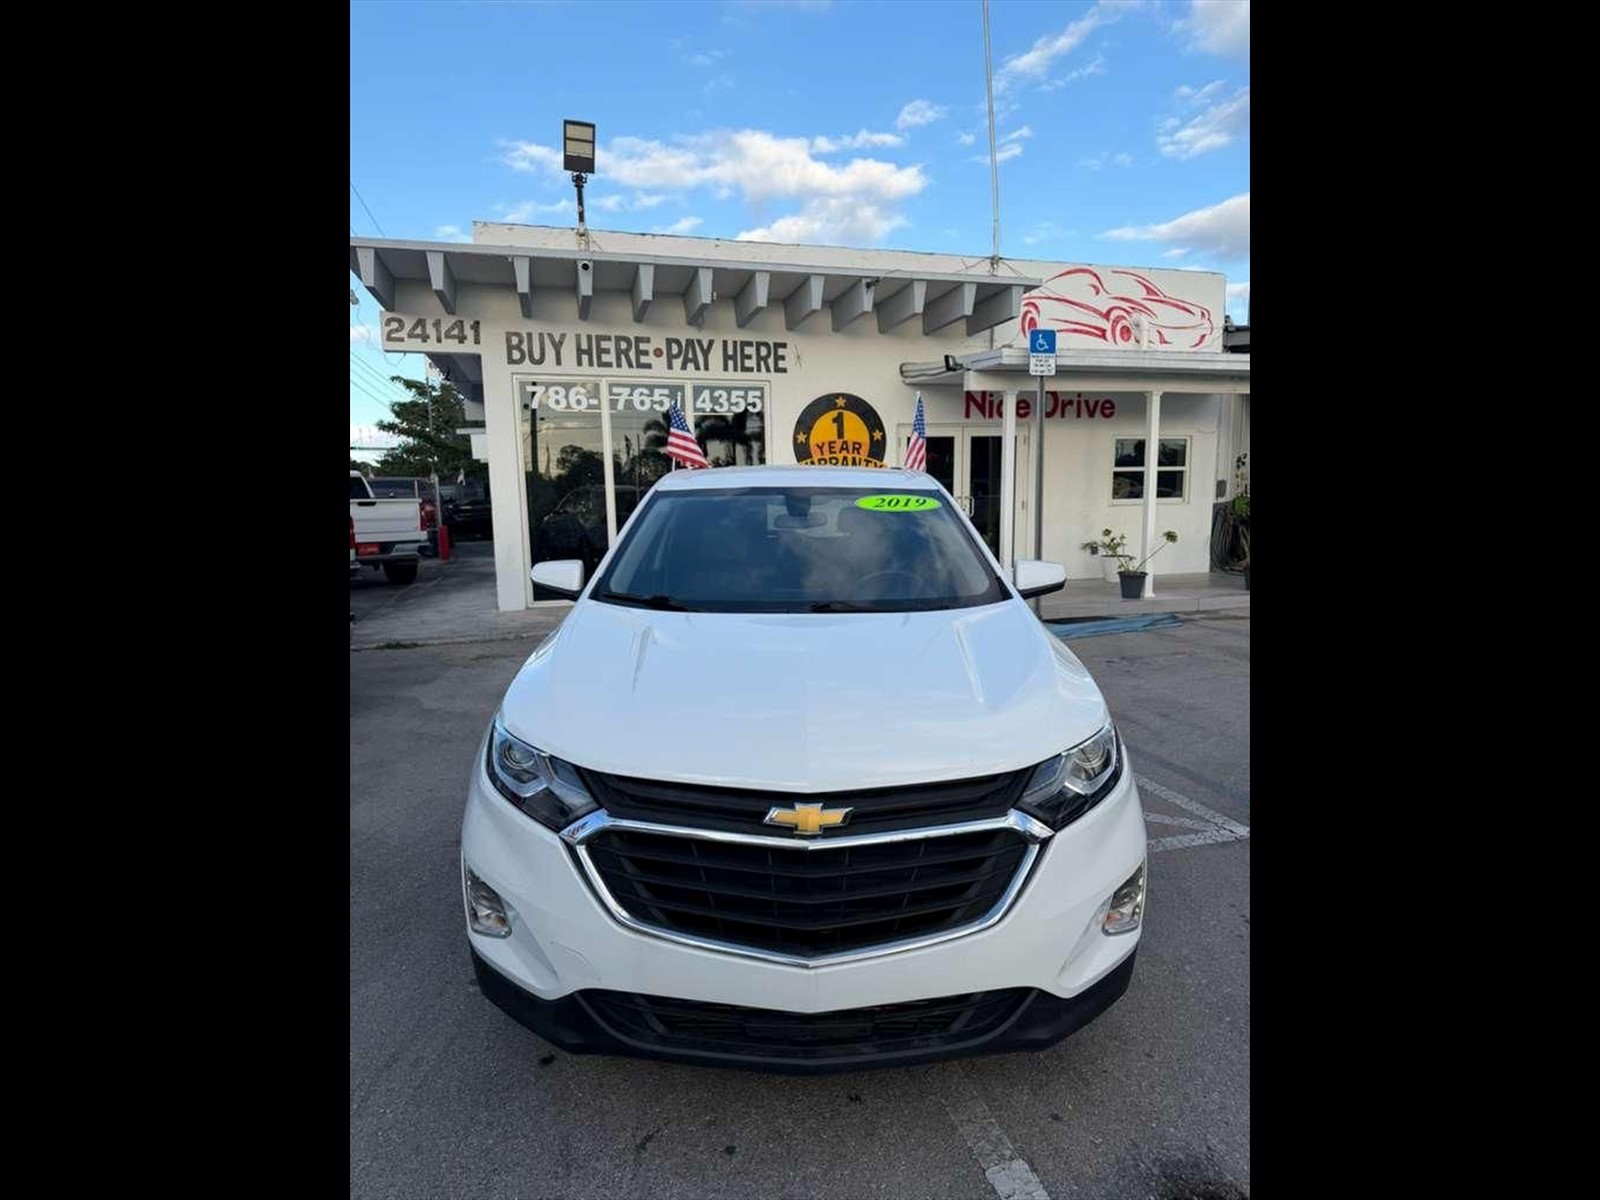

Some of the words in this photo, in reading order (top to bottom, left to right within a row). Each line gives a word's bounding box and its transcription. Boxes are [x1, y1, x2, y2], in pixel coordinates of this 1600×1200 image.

[384, 317, 481, 345] 24141
[505, 331, 567, 366] BUY
[575, 334, 652, 369] HERE
[665, 338, 715, 371] PAY
[722, 340, 788, 373] HERE
[695, 389, 762, 413] 4355
[1044, 391, 1115, 419] Drive
[832, 411, 845, 440] 1
[815, 440, 862, 456] YEAR
[803, 456, 888, 469] RRANT
[874, 497, 927, 508] 2019
